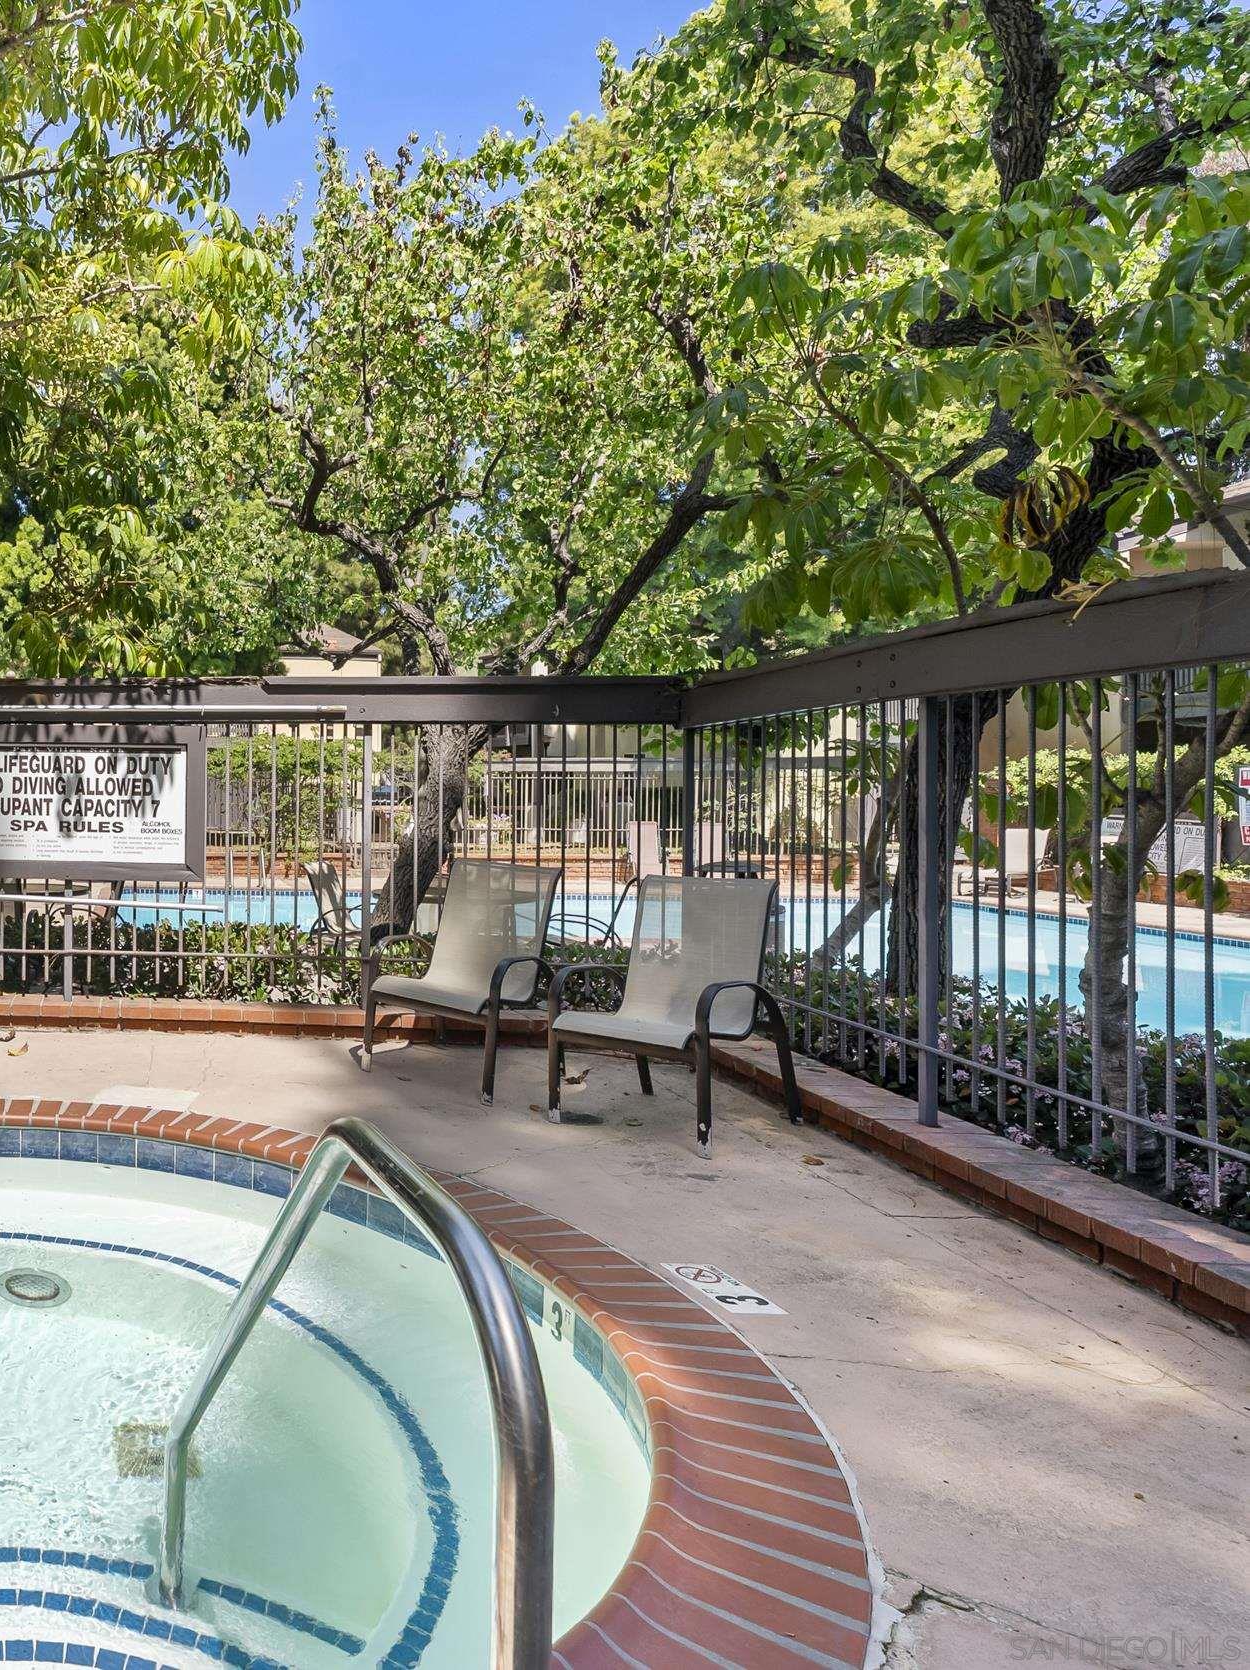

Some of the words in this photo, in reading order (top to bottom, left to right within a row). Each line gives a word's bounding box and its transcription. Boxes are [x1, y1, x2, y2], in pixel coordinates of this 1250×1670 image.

[95, 756, 117, 774] ON
[127, 757, 172, 775] DUTY
[12, 776, 66, 795] DIVING
[75, 777, 153, 796] ALLOWED
[61, 798, 142, 817] CAPACITY
[152, 800, 161, 818] 7
[10, 820, 48, 832] SPA
[59, 821, 124, 833] RULES
[715, 1295, 770, 1306] 3
[552, 1301, 563, 1342] 3
